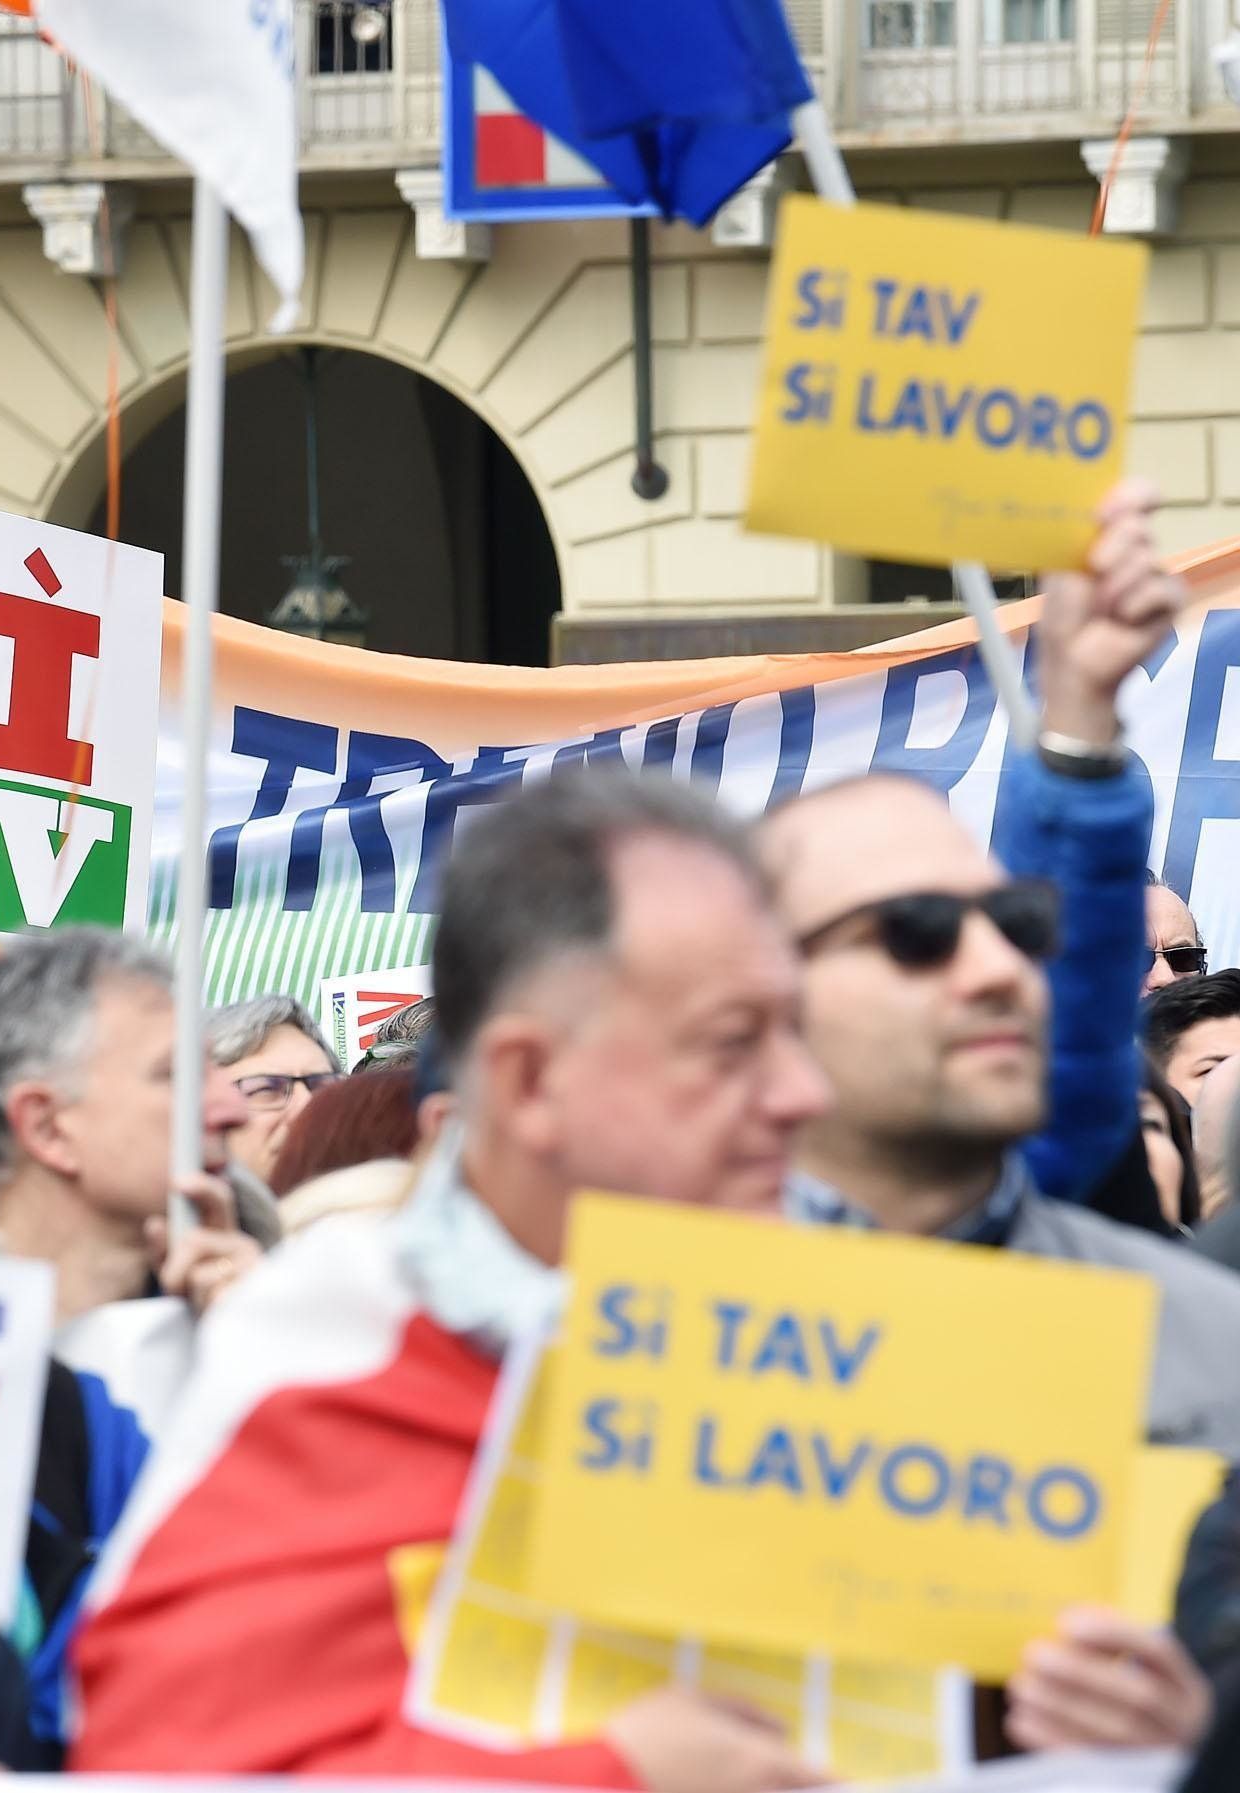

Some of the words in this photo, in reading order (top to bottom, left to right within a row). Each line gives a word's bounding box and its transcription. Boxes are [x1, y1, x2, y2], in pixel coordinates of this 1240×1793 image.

[871, 277, 983, 346] TAV
[855, 373, 1114, 462] LAVORO
[706, 1297, 881, 1387] TAV
[692, 1413, 1103, 1540] LAVORO
